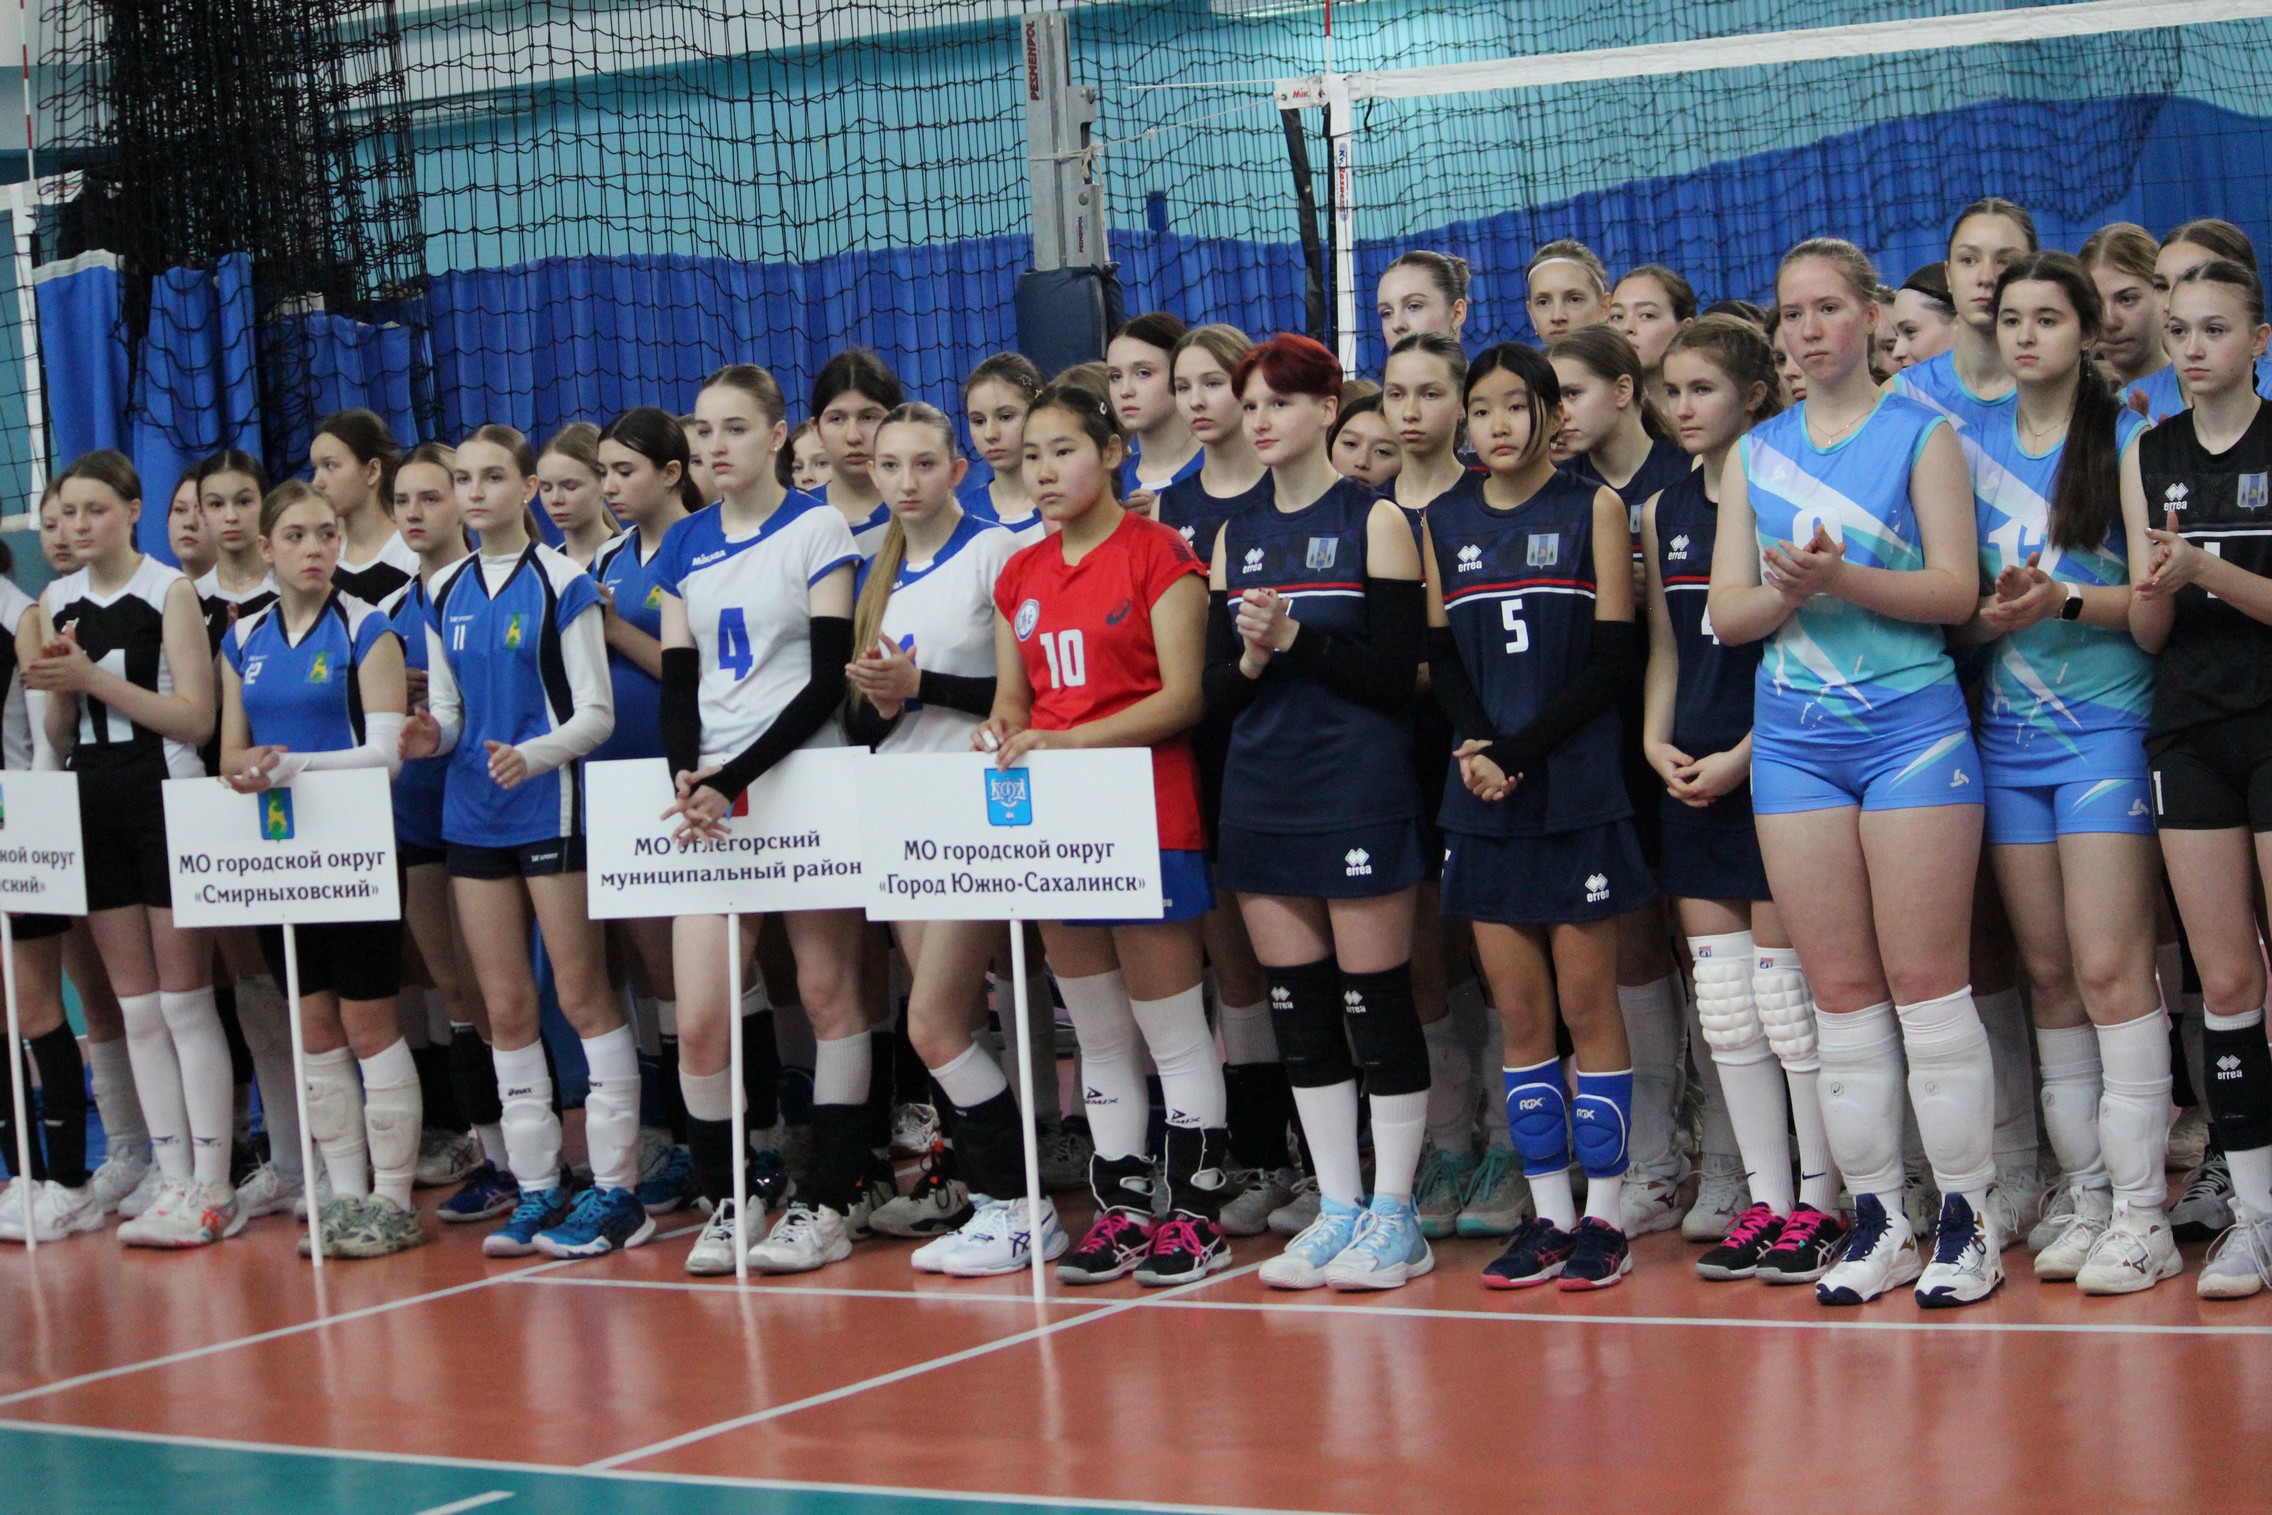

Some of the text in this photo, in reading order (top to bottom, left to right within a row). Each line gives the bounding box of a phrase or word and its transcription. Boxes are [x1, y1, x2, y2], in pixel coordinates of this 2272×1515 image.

[1026, 20, 1040, 101] PESMENPOL
[2163, 500, 2188, 511] errea
[1242, 562, 1263, 574] errea
[1458, 560, 1483, 573] errea
[1667, 550, 1688, 561] errea
[453, 624, 466, 651] 11
[1501, 598, 1529, 654] 5
[718, 607, 754, 681] 4
[1039, 628, 1086, 689] 10
[634, 836, 671, 856] МО
[904, 839, 1115, 865] МО городской округ
[32, 850, 75, 870] округ
[179, 850, 386, 877] МО городской округ
[1346, 864, 1372, 876] errea
[600, 859, 862, 890] муниципальный район
[879, 871, 1146, 899] «Город Южно-Сахалинск»
[195, 879, 379, 907] «Смирныховский»
[1586, 888, 1610, 903] errea
[2217, 1069, 2243, 1080] errea
